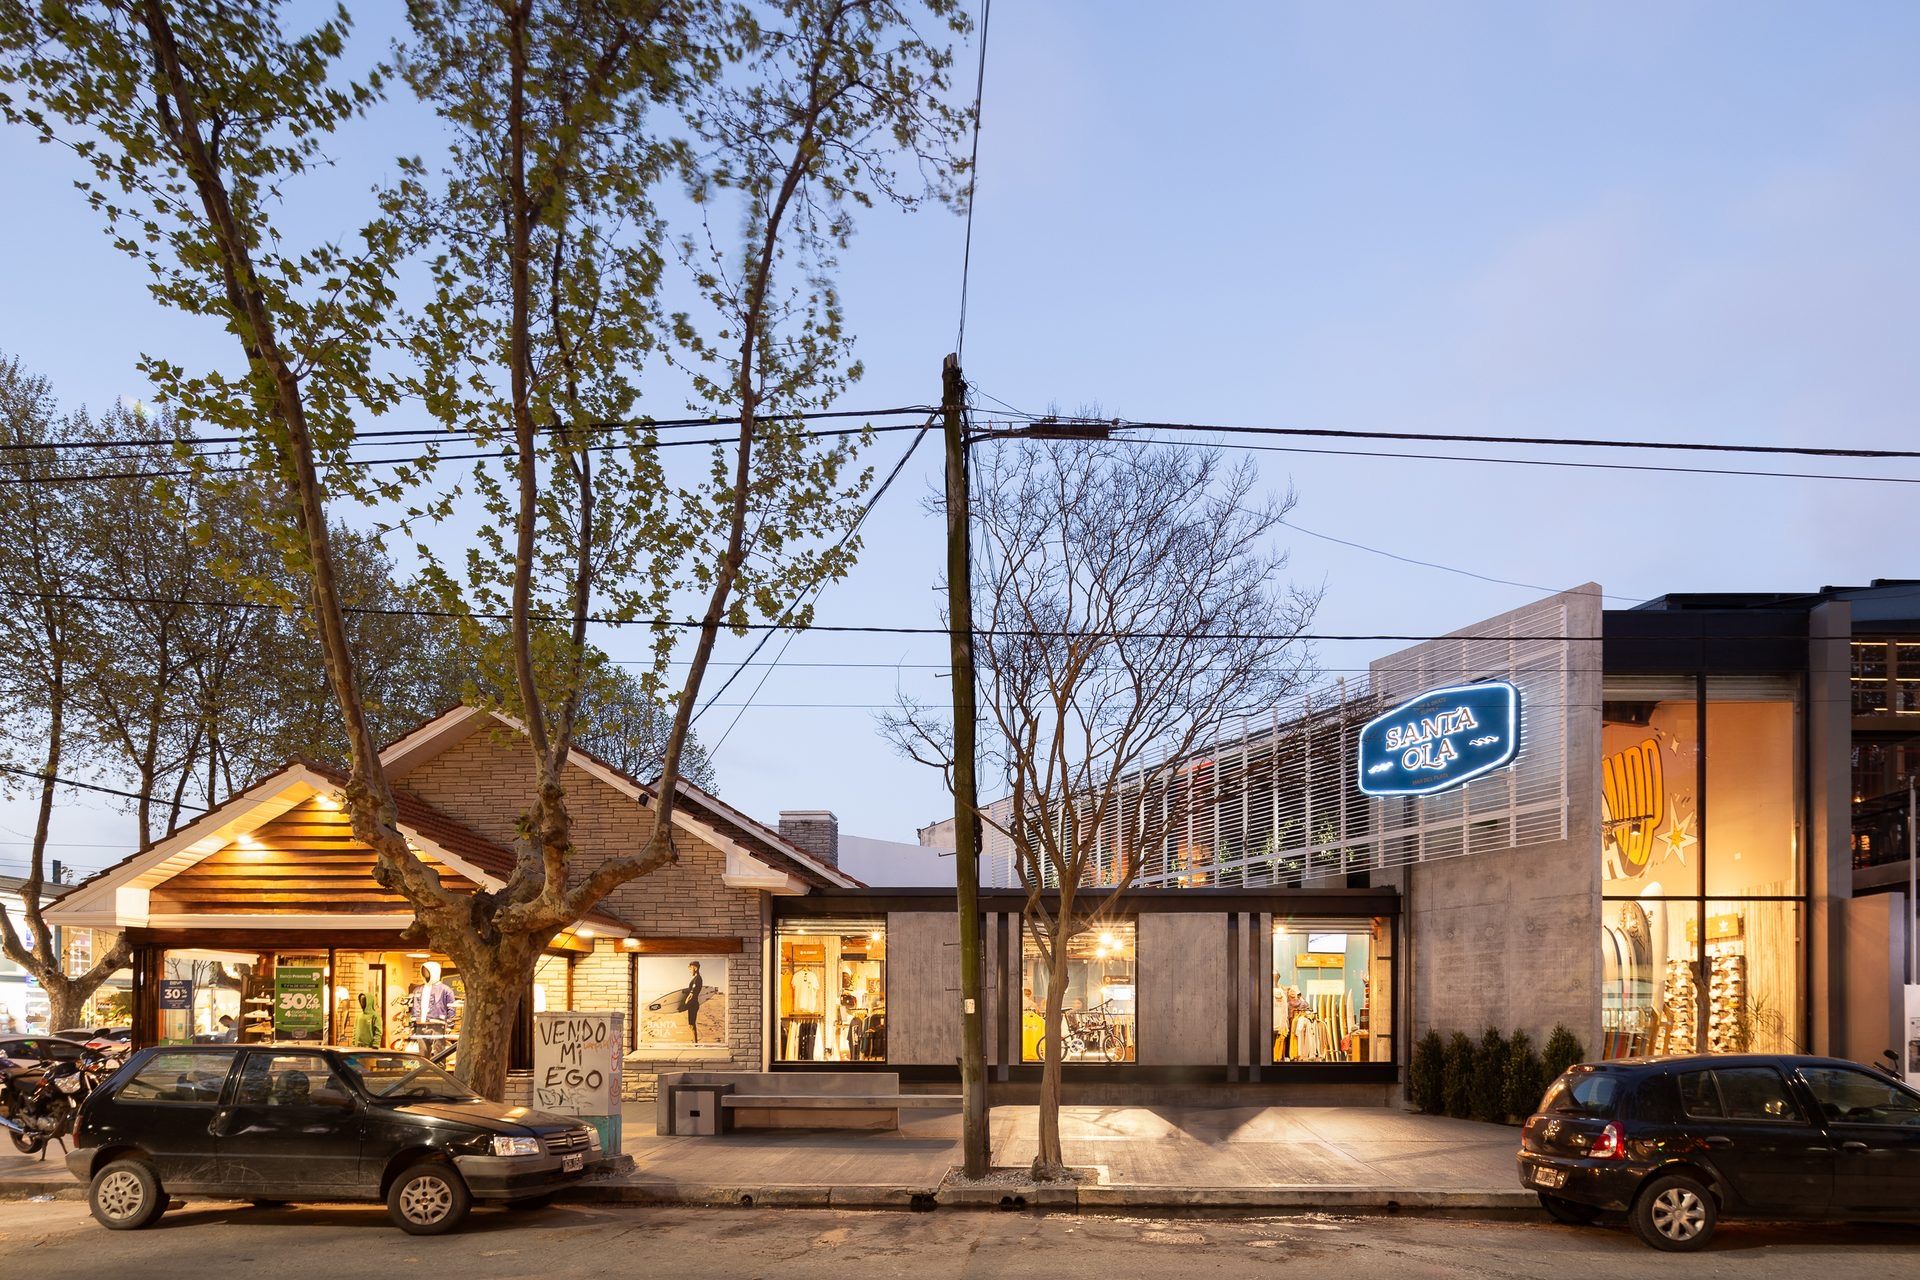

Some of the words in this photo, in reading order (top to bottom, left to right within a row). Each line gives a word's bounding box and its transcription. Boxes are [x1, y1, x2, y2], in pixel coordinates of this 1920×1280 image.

[1386, 706, 1478, 751] SANTA
[1402, 738, 1457, 770] OLA
[279, 993, 319, 1009] 30%
[540, 1019, 607, 1046] VENDO
[545, 1066, 603, 1090] EGO
